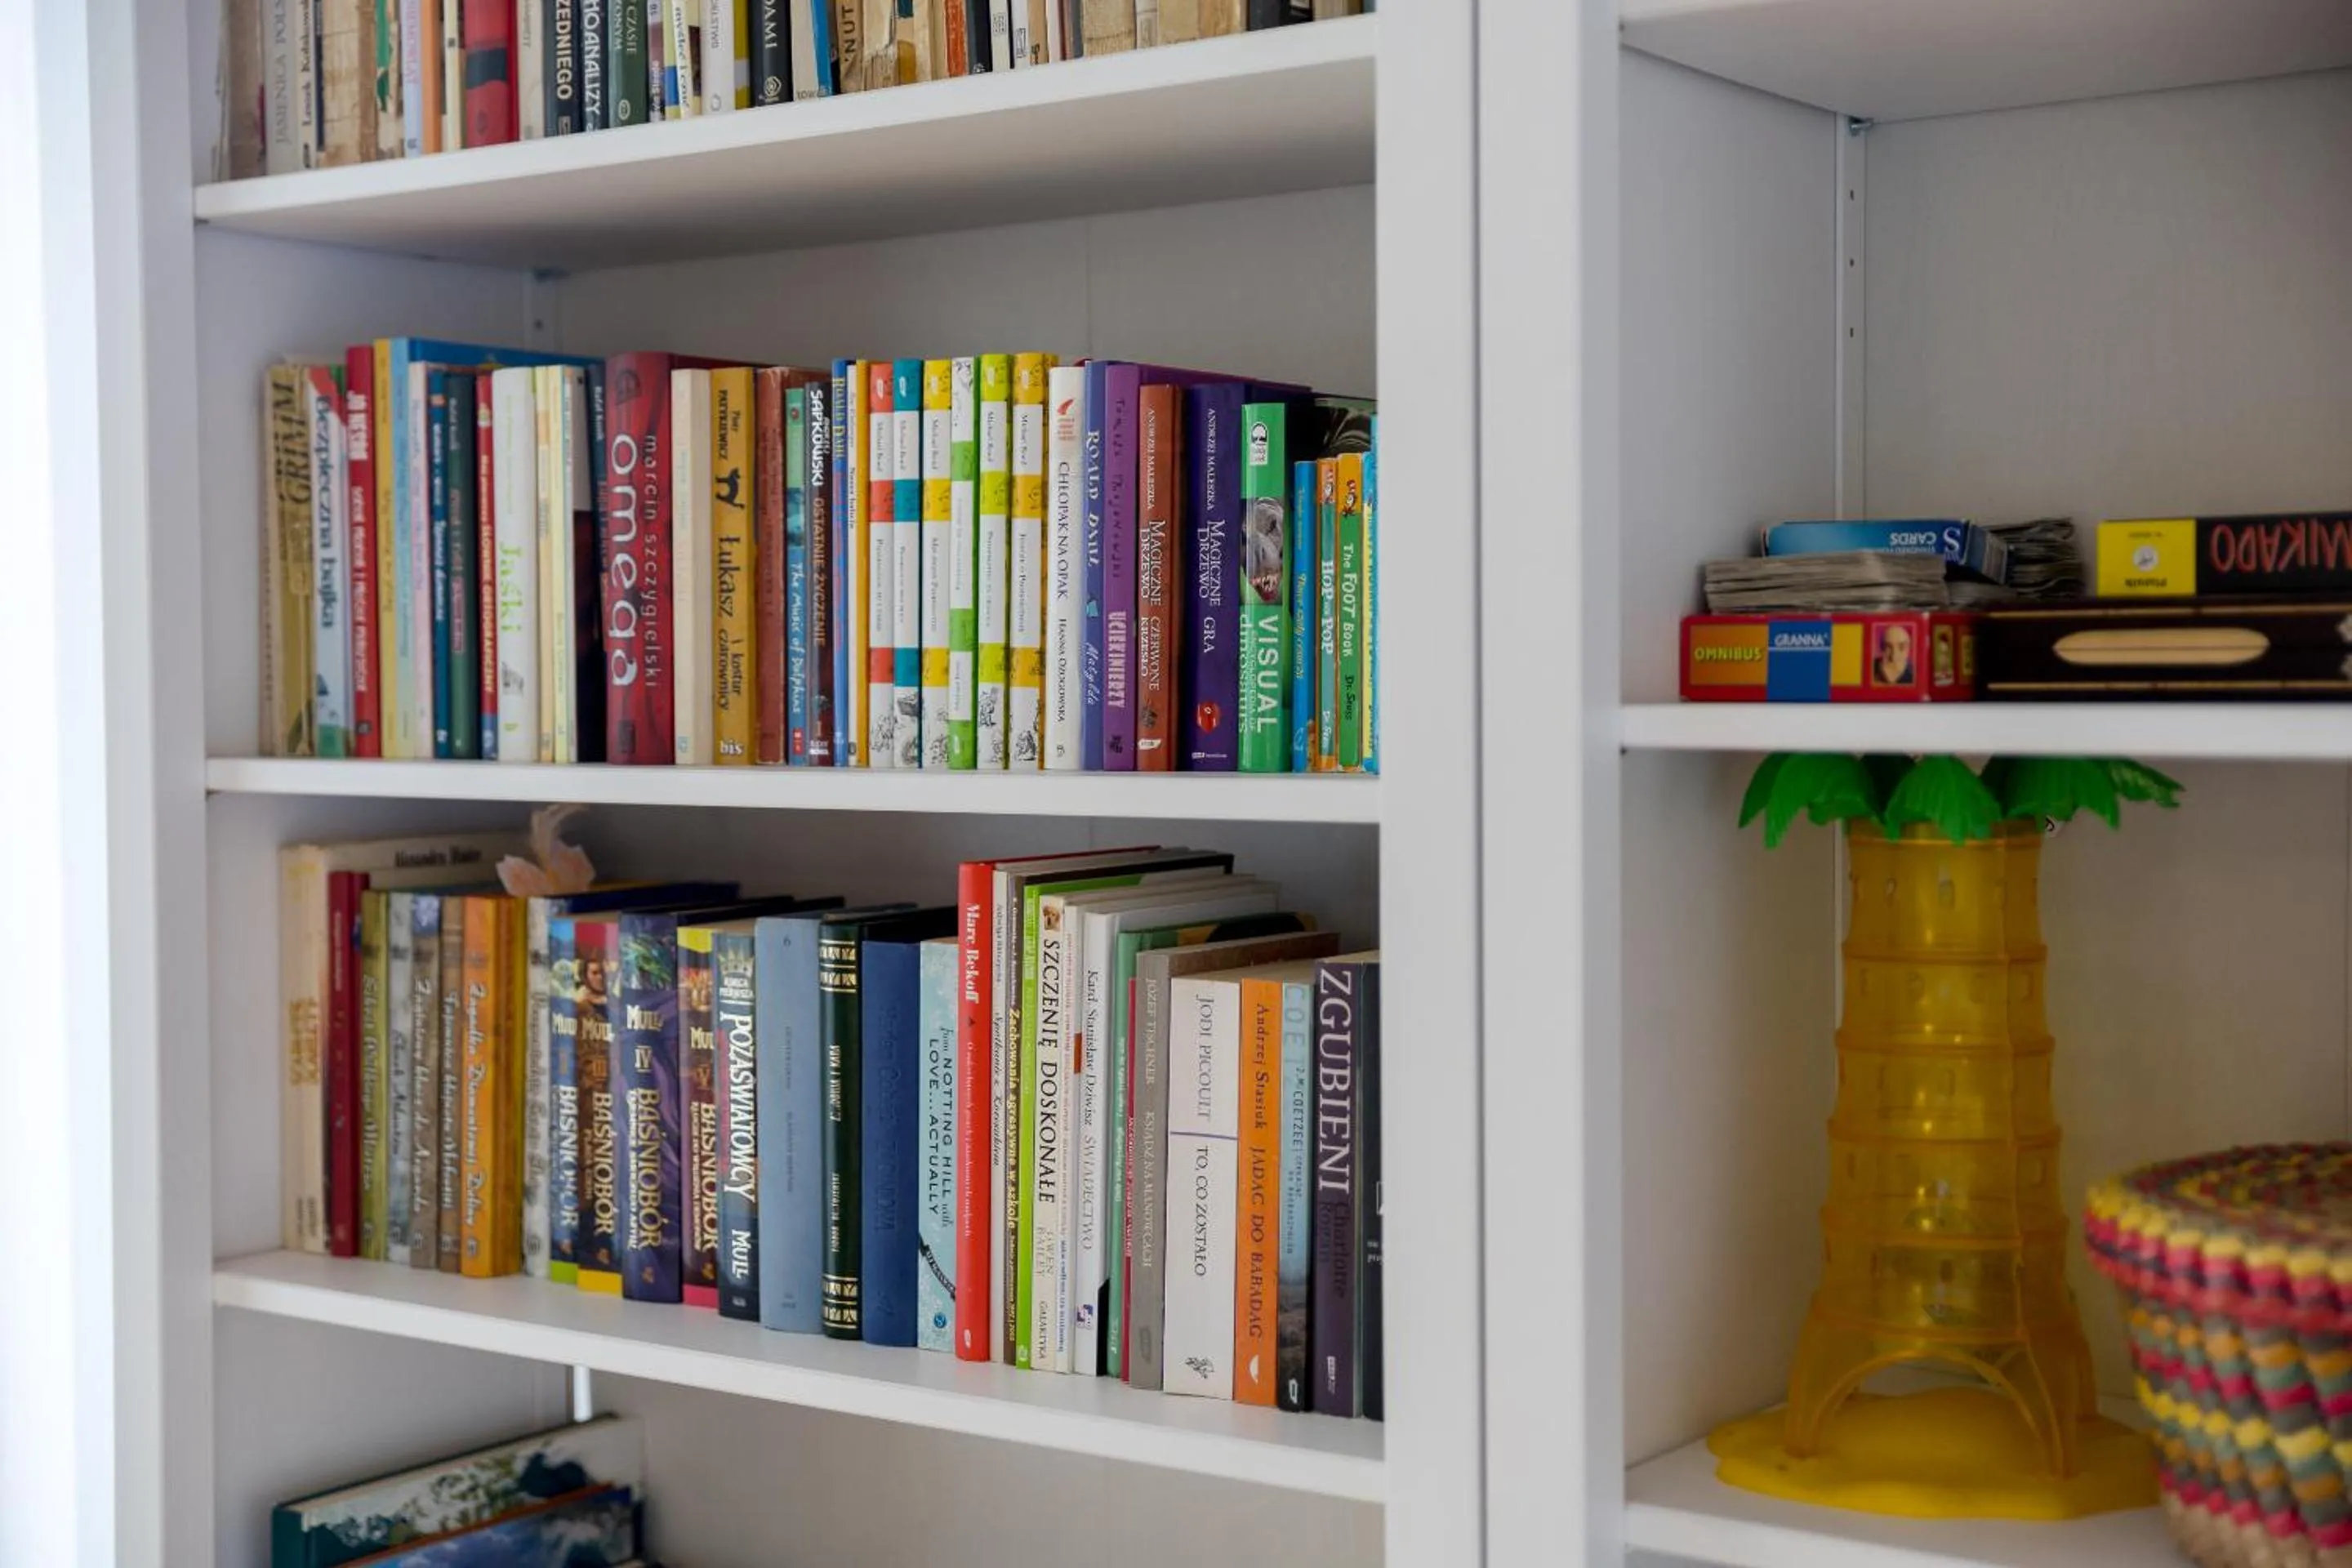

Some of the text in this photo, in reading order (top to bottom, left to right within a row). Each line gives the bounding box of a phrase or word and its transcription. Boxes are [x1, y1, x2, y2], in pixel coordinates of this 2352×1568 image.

[810, 390, 824, 488] SAPKOWSKI
[1146, 408, 1156, 510] ANDRZEJ MALESZKA
[1206, 408, 1216, 511] ANDRZEJ MALESZKA
[315, 396, 339, 630] Bezpieczna bajka
[1057, 461, 1071, 601] CHŁOPAK NA OPAK
[1086, 430, 1101, 567] ROALD DAHL
[1890, 532, 1937, 545] CARDS
[608, 434, 639, 687] omega
[641, 435, 662, 688] marcin szczygielski
[718, 537, 742, 619] Łukasz
[813, 497, 828, 646] OSTATNIE ŻYCZENIE
[1139, 529, 1150, 599] DRZEWO
[1149, 519, 1166, 607] MAGICZNE
[1197, 529, 1209, 599] DRZEWO
[1209, 519, 1226, 607] MAGICZNE
[1342, 543, 1358, 618] The FOOT
[790, 563, 807, 714] The Music of Dolphins
[1058, 617, 1067, 655] HANNA
[1140, 617, 1149, 678] KRZESŁO
[1203, 616, 1216, 654] GRA
[1321, 559, 1334, 655] HOP POP
[718, 628, 732, 713] czarownicy
[732, 653, 744, 697] kostur
[1084, 643, 1100, 706] Matylda
[1107, 610, 1127, 709] UCIEKINIERZY
[1149, 616, 1160, 692] CZERWONE
[1238, 613, 1256, 734] dinosaurs
[1257, 614, 1279, 734] VISUAL
[1694, 646, 1763, 662] OMNIBUS
[1345, 675, 1356, 723] Dr. Seuss
[965, 902, 982, 1004] Marc Bekoff
[467, 980, 488, 1055] Zagadka
[940, 1027, 955, 1052] from
[993, 1013, 1009, 1077] Spotkanie
[1008, 1008, 1021, 1089] Zachowania
[1085, 1009, 1098, 1069] Stanisław
[1196, 994, 1214, 1120] JODI PICOULT
[942, 1056, 953, 1147] NOTTING
[1038, 938, 1060, 1204] SZCZENIĘ DOSKONAŁE
[1084, 1073, 1098, 1126] Dziwisz
[1254, 1004, 1270, 1129] Andrzej Stasiuk
[1318, 968, 1352, 1195] ZGUBIENI
[593, 1089, 619, 1236] BAŚNIOBÓR
[1006, 1094, 1019, 1165] agresywne
[1292, 1090, 1304, 1147] COETZEE
[637, 1087, 669, 1250] BAŚNIOBÓR
[928, 1113, 939, 1215] ACTUALLY
[942, 1156, 952, 1198] HILL
[1008, 1186, 1021, 1229] szkole
[1009, 1169, 1017, 1181] w
[1080, 1134, 1098, 1251] ŚWIADECTWO
[731, 1228, 752, 1280] MULL
[1194, 1146, 1209, 1276] TO, CO ZOSTAŁO
[1249, 1214, 1265, 1339] DO BABADAG
